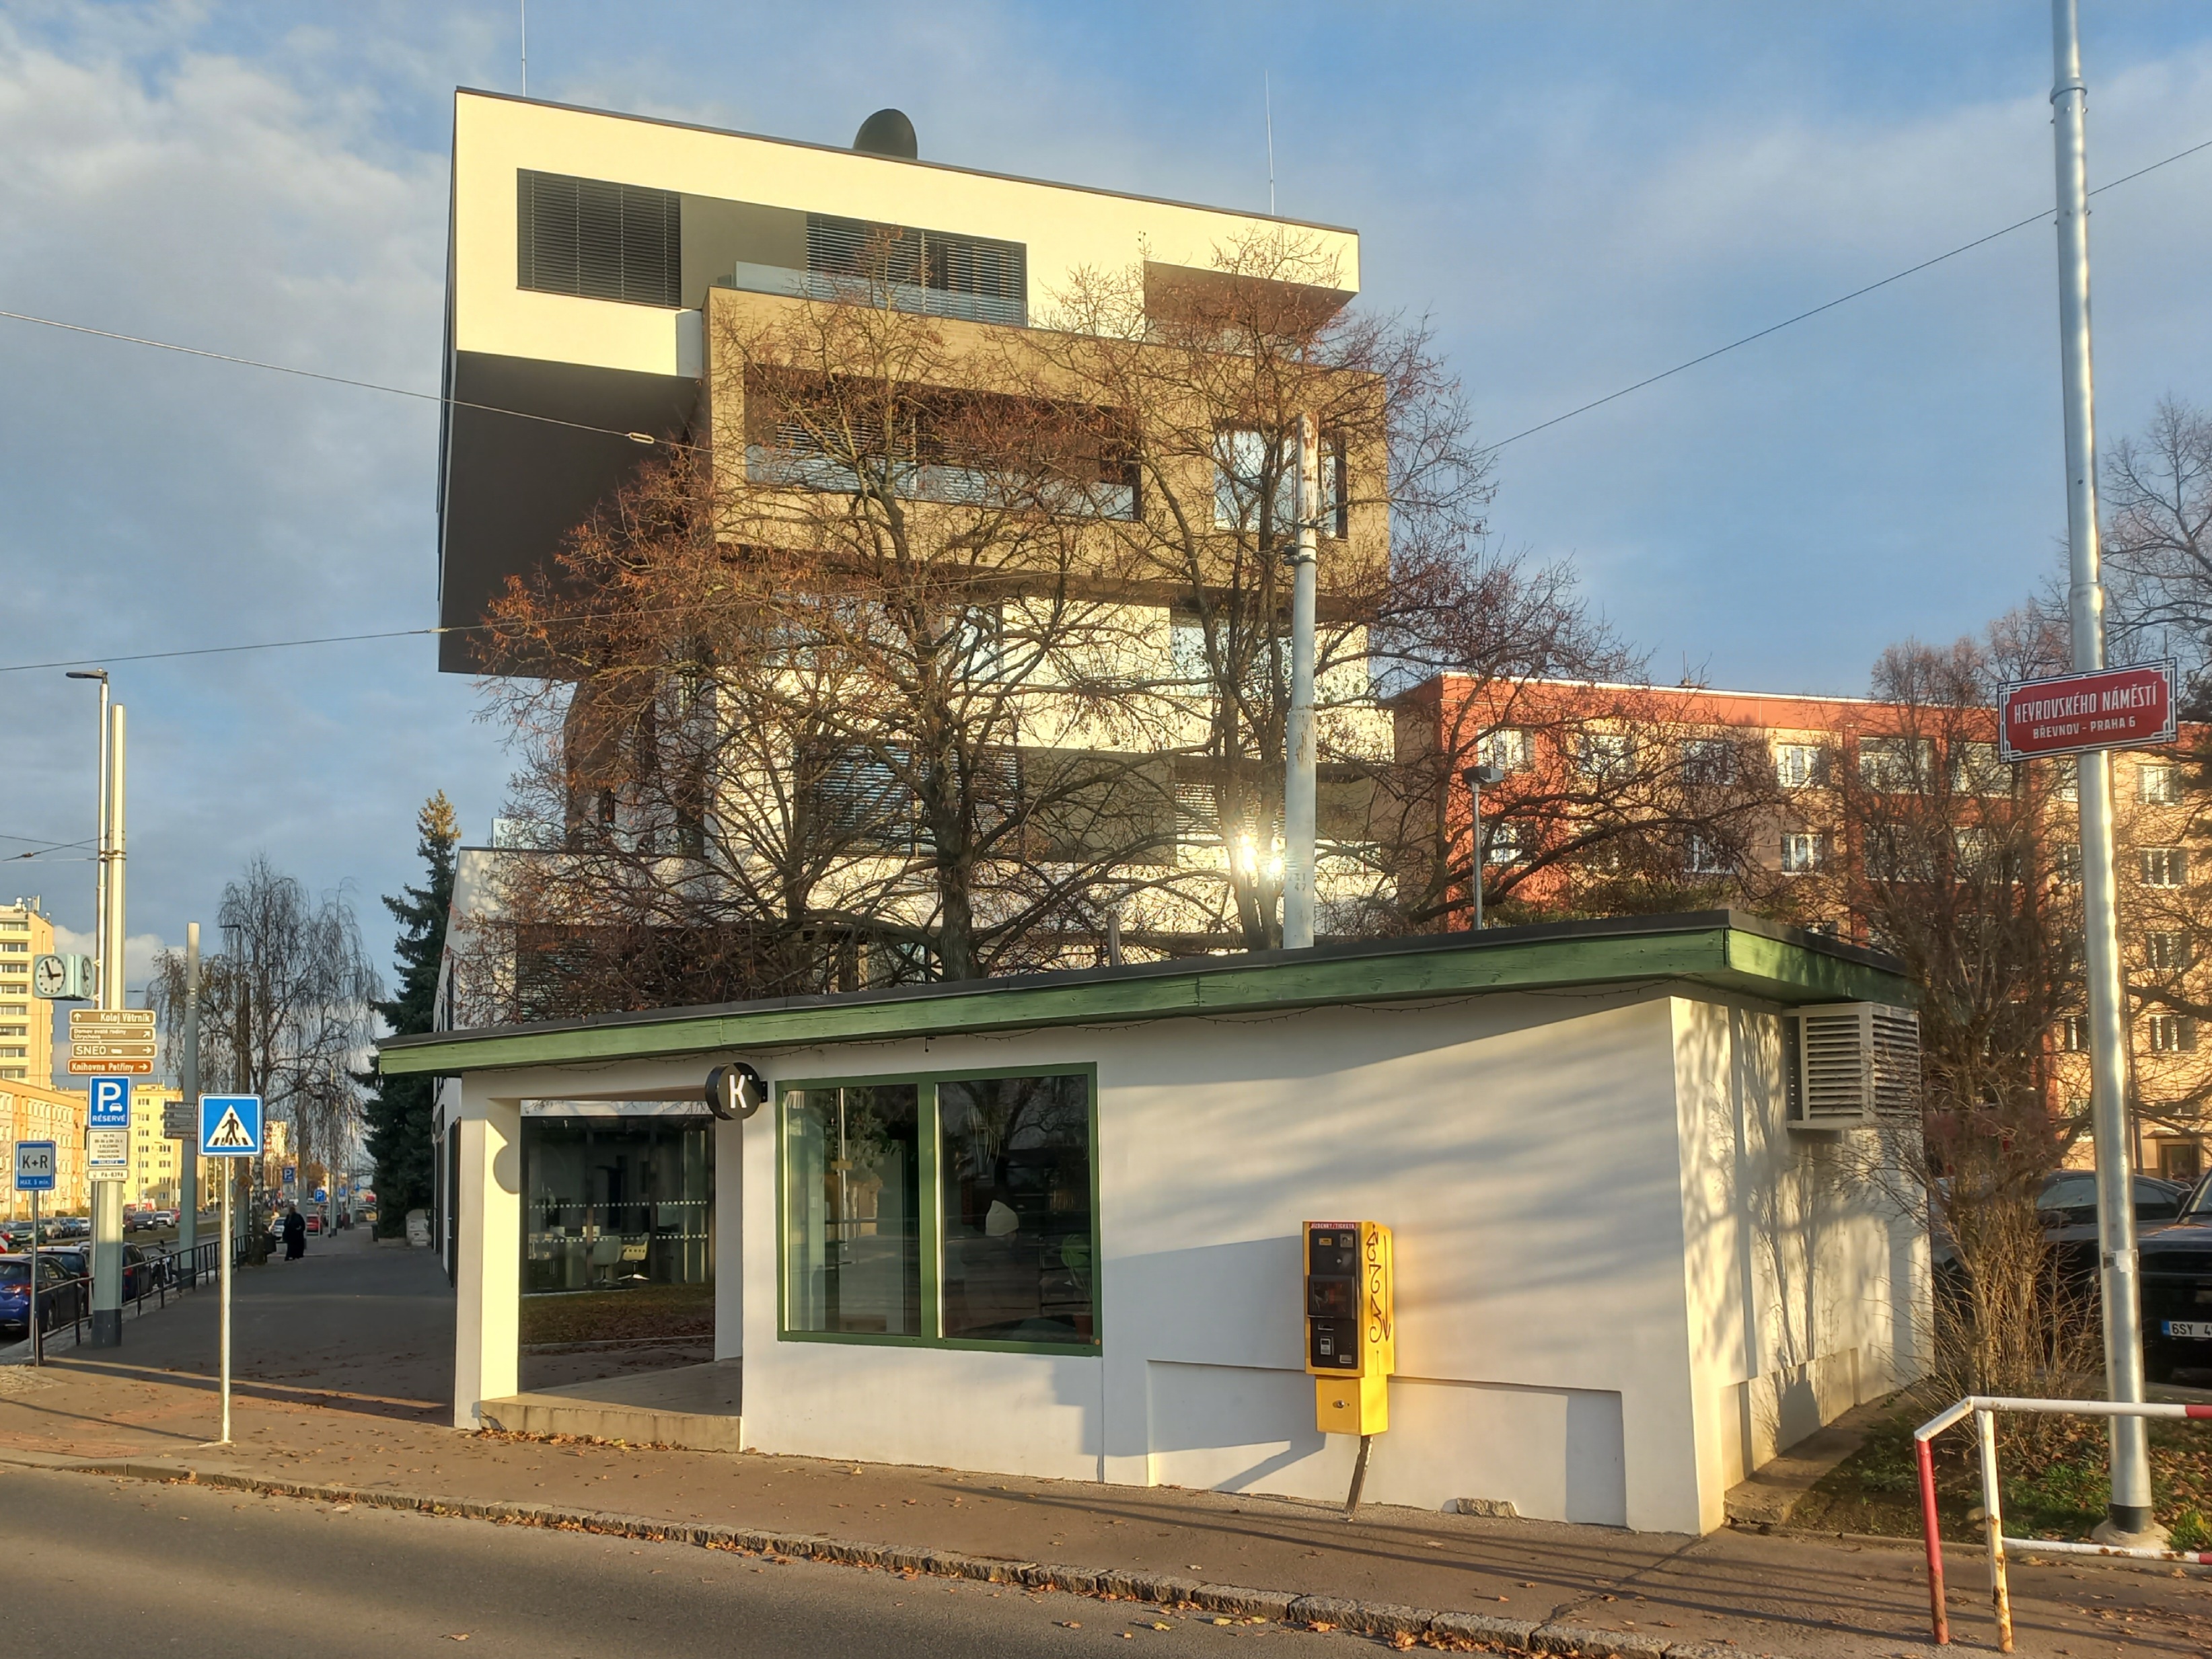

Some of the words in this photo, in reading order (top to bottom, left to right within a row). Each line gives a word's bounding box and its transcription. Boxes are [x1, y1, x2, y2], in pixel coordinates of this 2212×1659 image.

[2014, 692, 2097, 725] HEYROVSKÉHO
[2102, 681, 2158, 712] NÁMĚSTÍ
[2032, 723, 2079, 739] BŘEVNOV
[2090, 717, 2126, 733] PRAHA
[2129, 716, 2136, 728] 6
[100, 1012, 120, 1023] Kolej
[122, 1012, 151, 1023] Větrník
[75, 1045, 106, 1055] SNEO
[71, 1063, 106, 1071] Knihovna
[108, 1063, 135, 1073] Petřiny
[98, 1082, 122, 1112] P
[92, 1113, 126, 1122] RÉSERVÉ
[284, 1169, 292, 1179] P
[316, 1191, 323, 1200] P
[2172, 1323, 2193, 1335] 6SY
[2204, 1325, 2212, 1336] 4
